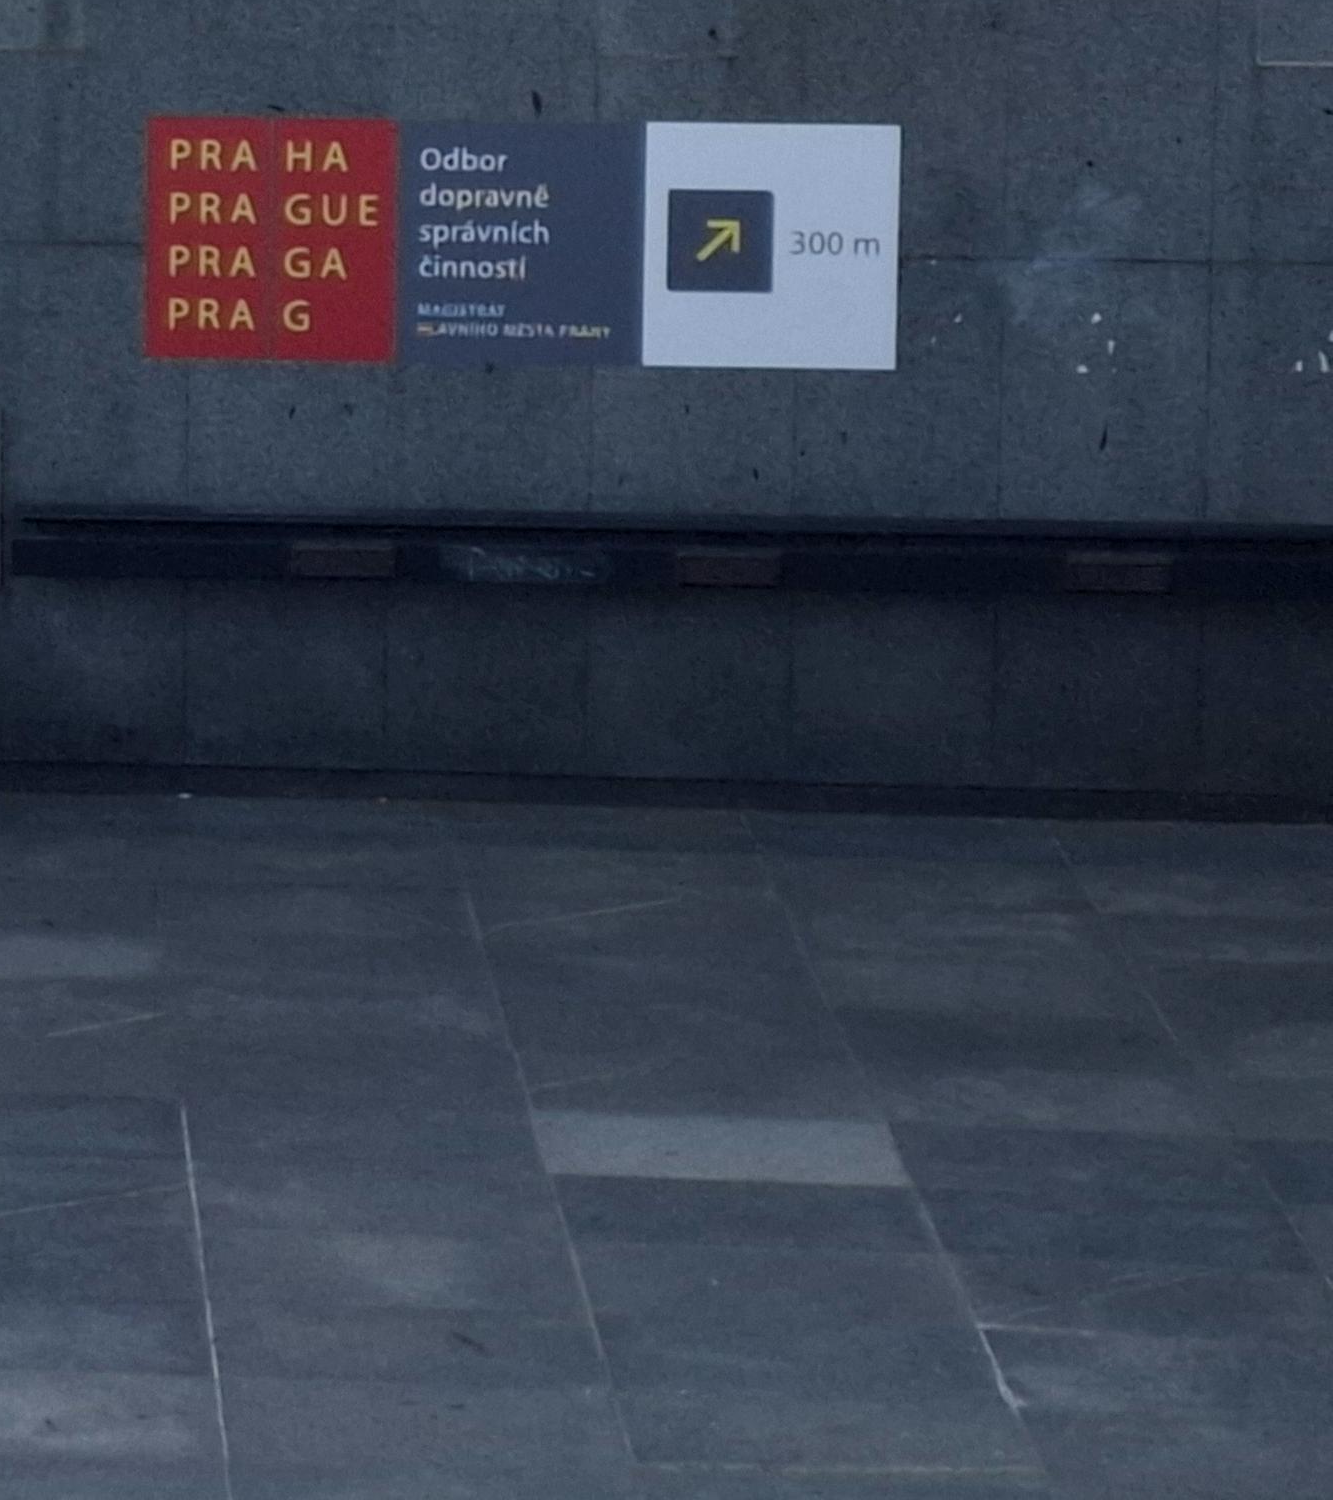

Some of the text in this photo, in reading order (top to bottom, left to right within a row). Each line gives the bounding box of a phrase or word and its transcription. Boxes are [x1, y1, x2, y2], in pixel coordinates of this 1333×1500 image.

[169, 139, 349, 173] PRA HA
[419, 146, 509, 172] Odbor
[169, 191, 380, 226] PRA GUE
[419, 182, 550, 211] dopravně
[418, 219, 551, 249] správních
[789, 231, 881, 257] 300 m
[168, 245, 348, 280] PRA GA
[418, 254, 527, 280] činností
[167, 298, 311, 332] PRA G
